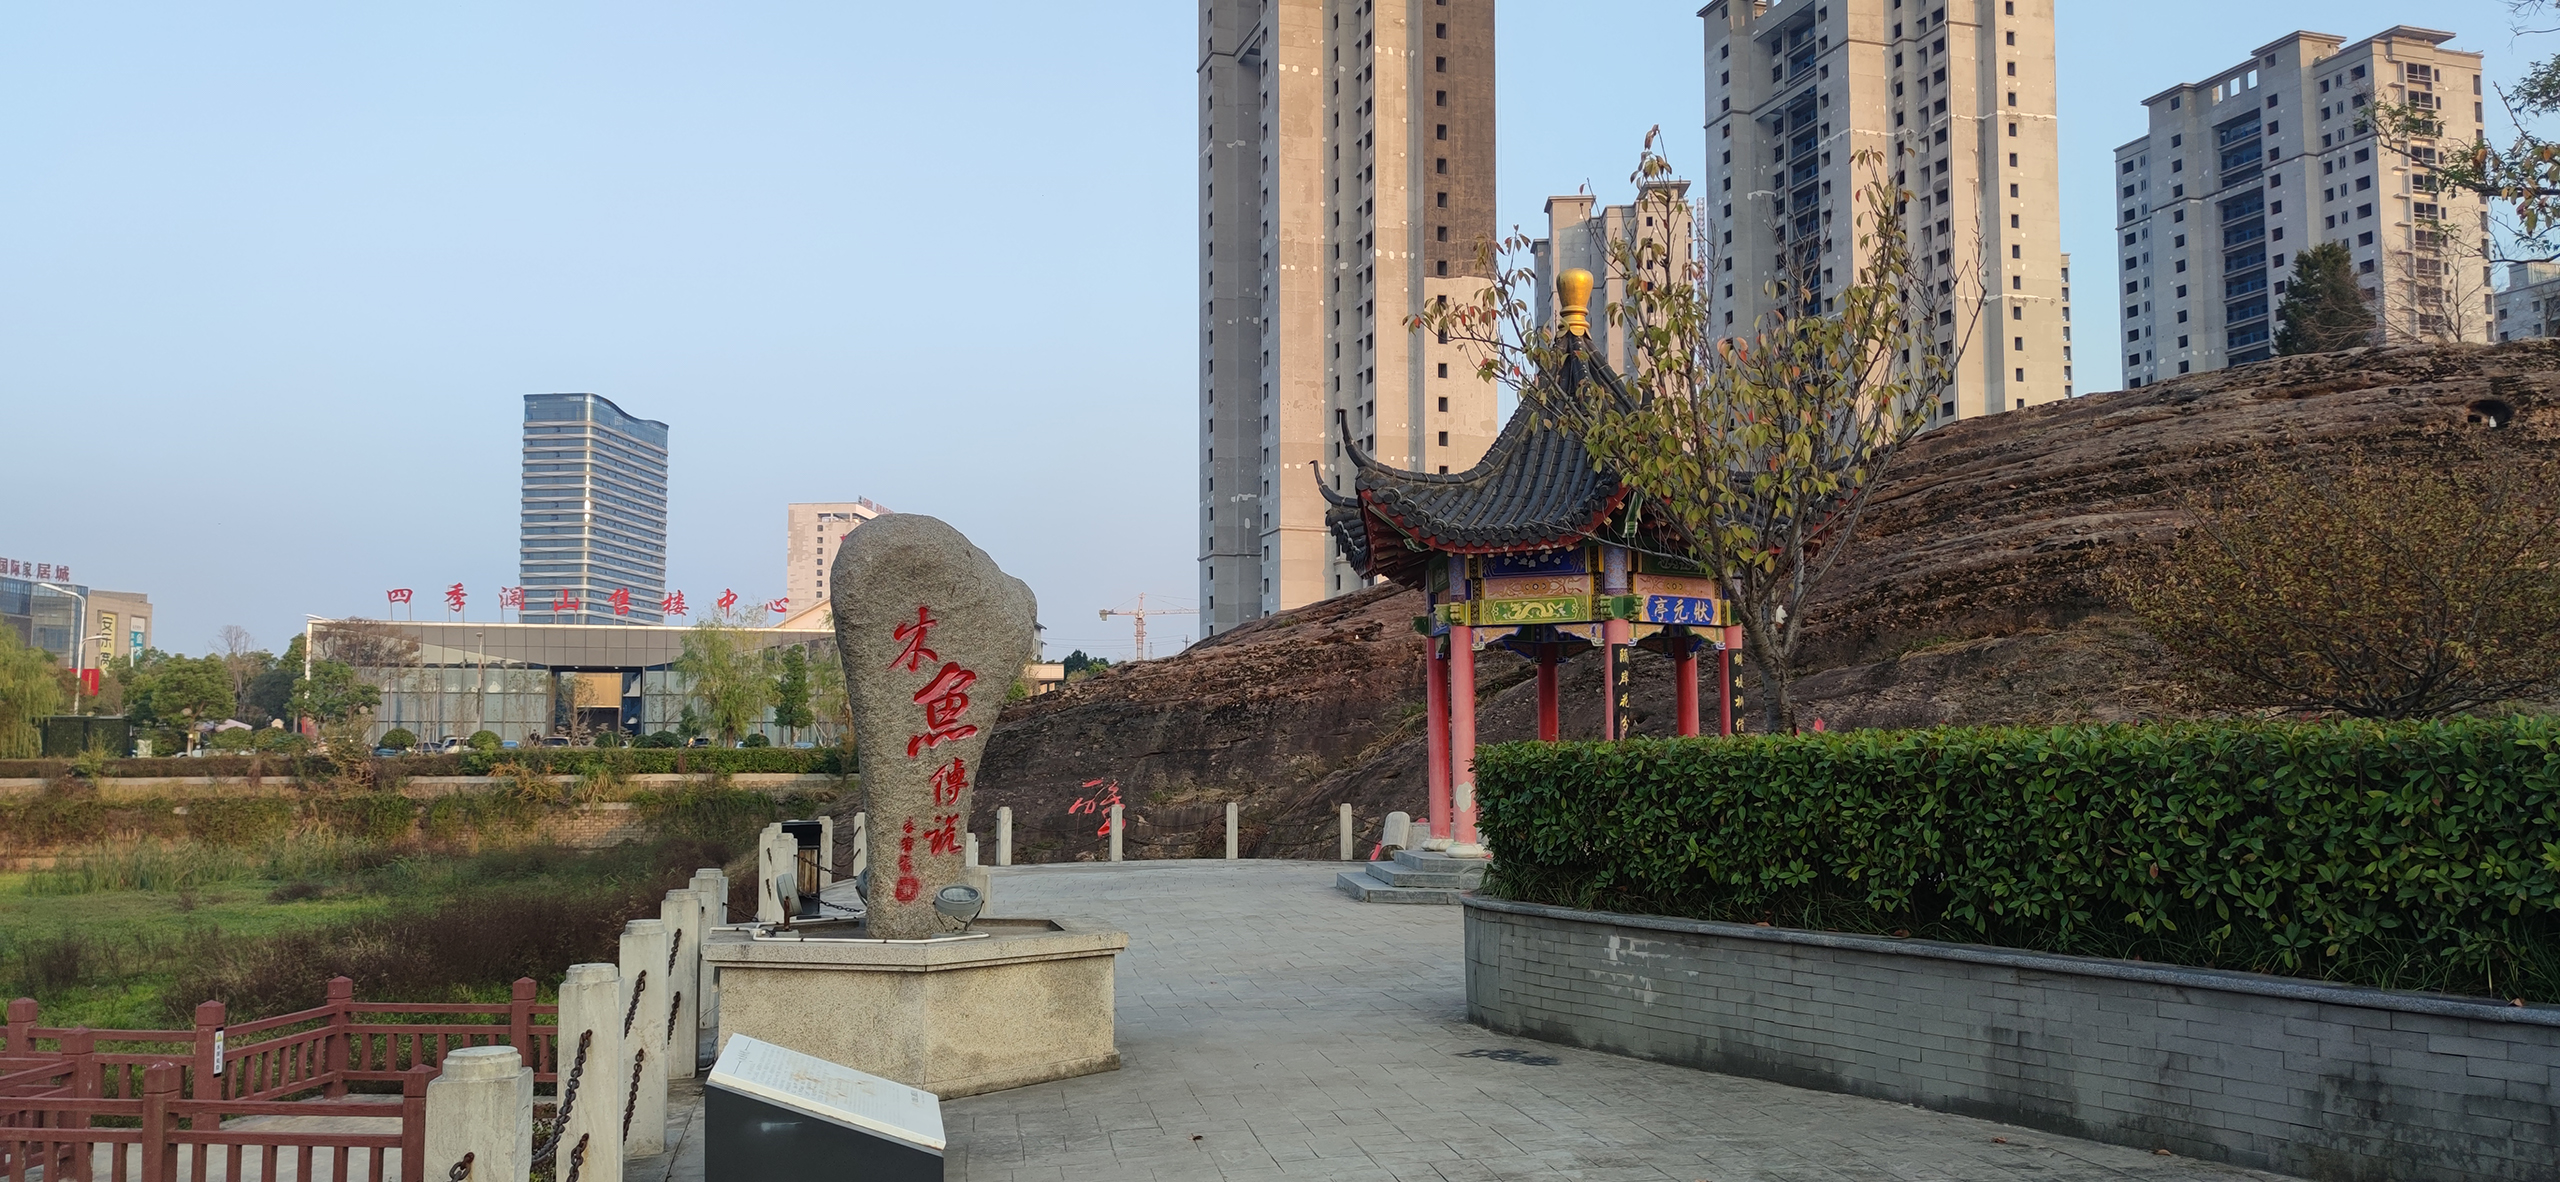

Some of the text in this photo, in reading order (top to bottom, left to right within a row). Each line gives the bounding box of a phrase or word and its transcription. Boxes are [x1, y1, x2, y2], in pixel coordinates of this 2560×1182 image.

[387, 582, 790, 619] 四季澜山售楼中心
